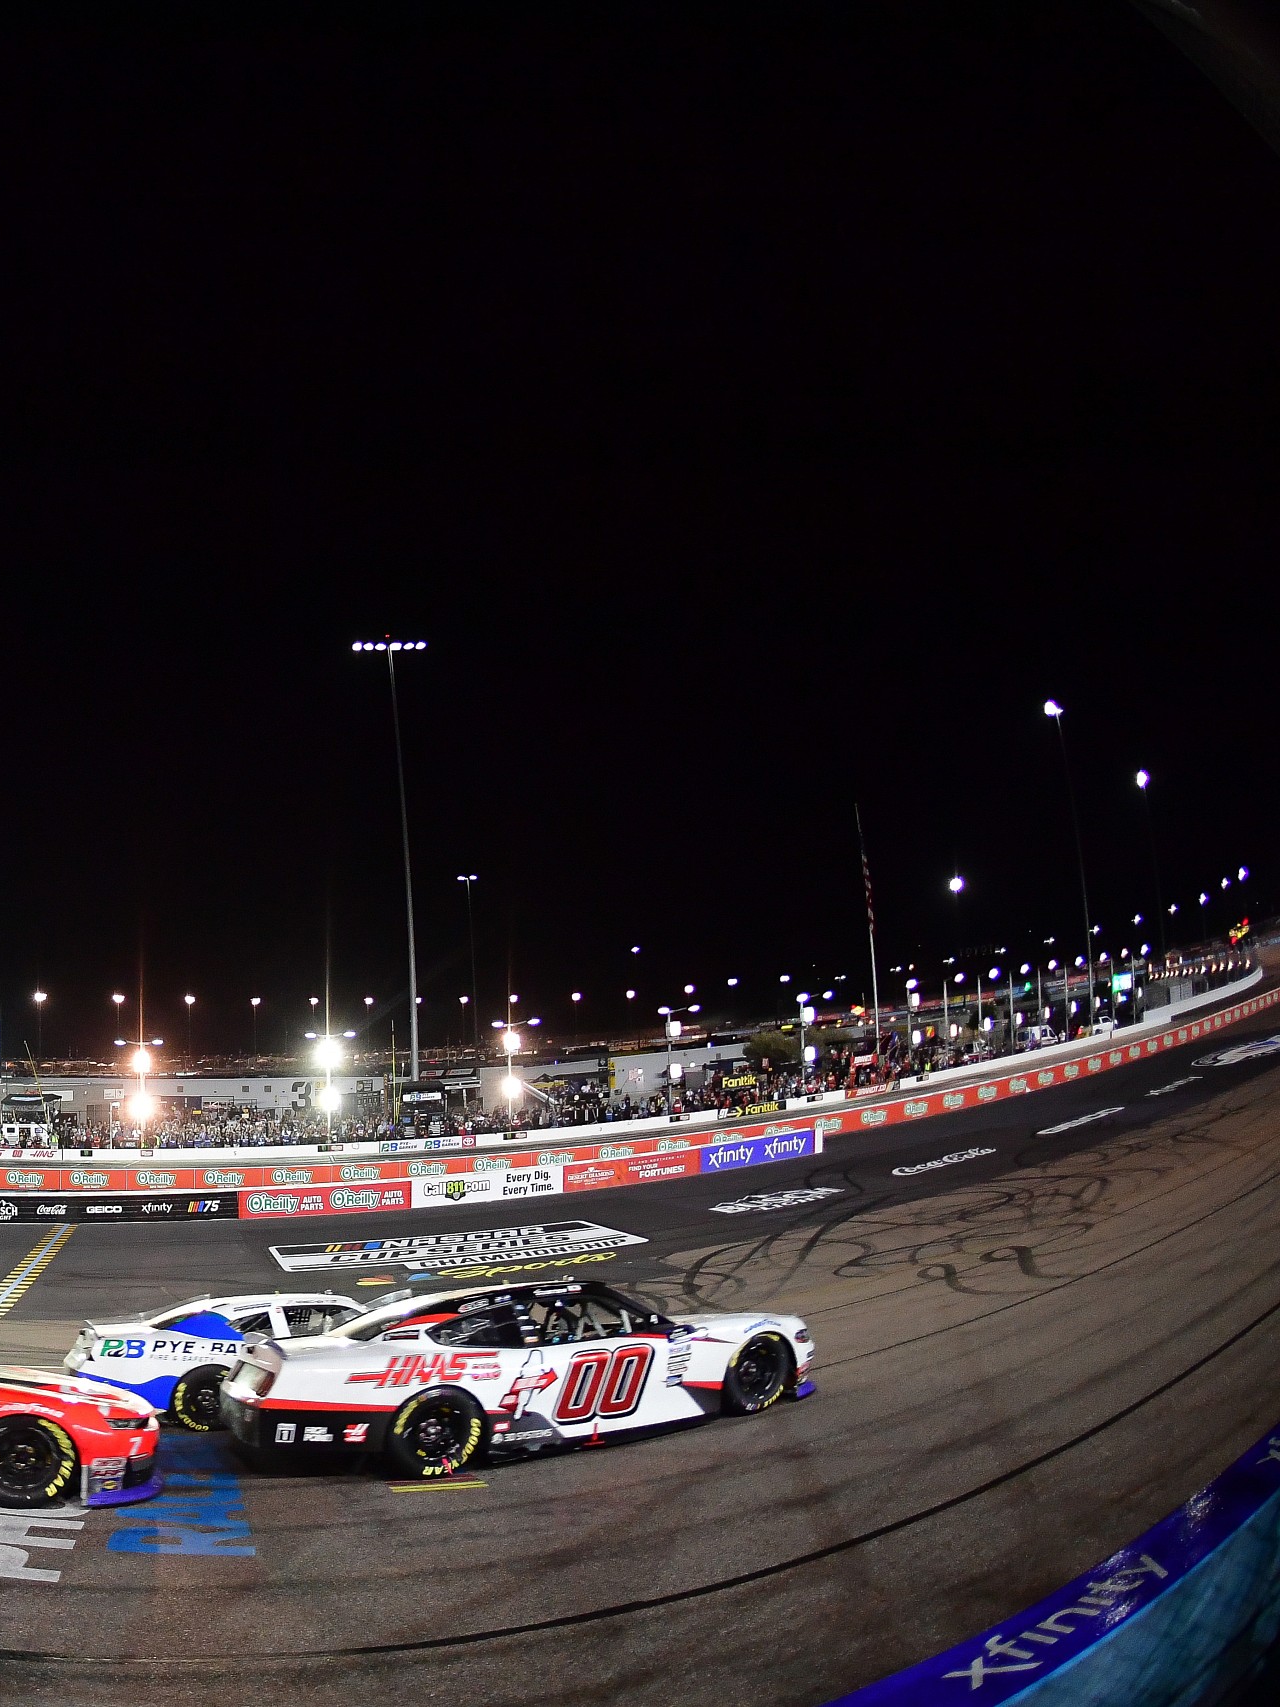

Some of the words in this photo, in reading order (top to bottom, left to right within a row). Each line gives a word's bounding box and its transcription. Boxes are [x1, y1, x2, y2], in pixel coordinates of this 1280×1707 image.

[722, 1074, 756, 1088] Fanttik
[292, 1082, 311, 1111] 3
[745, 1103, 779, 1115] Fanttik
[537, 1152, 575, 1166] O'Reilly
[599, 1145, 634, 1158] O'Reilly
[708, 1147, 754, 1168] xfinity
[764, 1137, 807, 1158] xfinity
[408, 1160, 448, 1176] O'Reilly
[474, 1156, 512, 1172] O'Reilly
[892, 1147, 997, 1176] Coca-Cola
[6, 1170, 45, 1188] O'Reilly
[70, 1170, 109, 1189] O'Reilly
[136, 1170, 176, 1189] O'Reilly
[204, 1169, 244, 1186] O'Reilly
[272, 1168, 313, 1184] O'Reilly
[340, 1164, 381, 1181] O'Reilly
[506, 1172, 531, 1183] Every
[534, 1170, 551, 1181] Dig.
[567, 1173, 588, 1181] DESERT
[589, 1170, 614, 1178] DIAMOND
[639, 1165, 685, 1178] FORTUNES!
[384, 1190, 402, 1198] AUTO
[503, 1185, 528, 1196] Every
[530, 1182, 554, 1193] Time.
[203, 1200, 220, 1212] 75
[248, 1193, 299, 1213] O'Reilly
[300, 1202, 324, 1210] PARTS
[330, 1188, 381, 1209] O'Reilly
[381, 1197, 404, 1206] PARTS
[86, 1205, 122, 1213] GEICO
[141, 1202, 173, 1213] xfinity
[381, 1226, 546, 1249] NASCAR
[330, 1249, 417, 1263] CUP
[427, 1233, 571, 1254] SERIES
[419, 1238, 628, 1268] CHAMPIONSHIP
[437, 1251, 618, 1279] Sports
[152, 1341, 196, 1354] PYE
[551, 1343, 655, 1426] 00
[129, 1437, 142, 1454] 7
[941, 1553, 1169, 1691] xfinity
